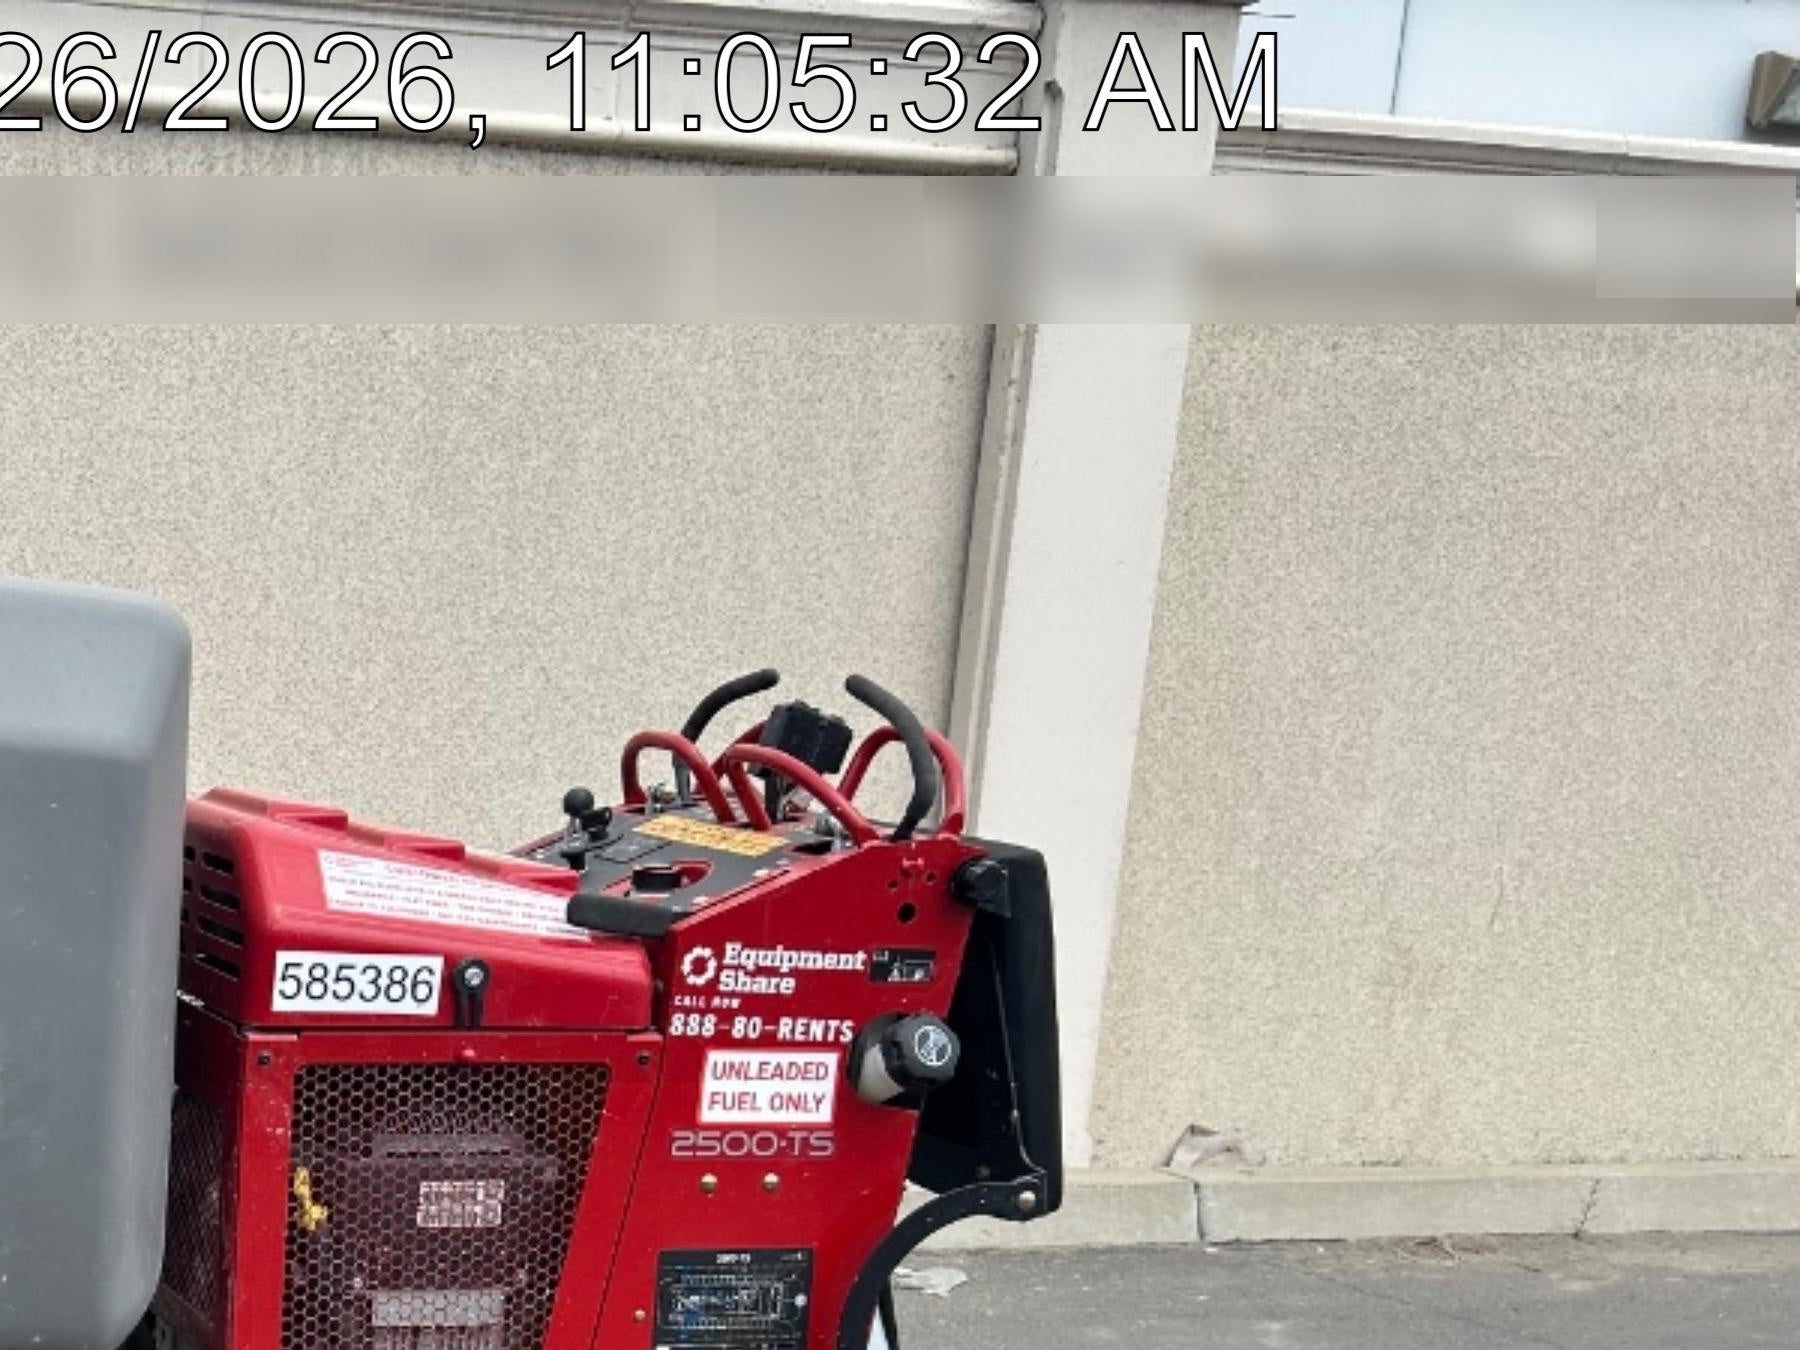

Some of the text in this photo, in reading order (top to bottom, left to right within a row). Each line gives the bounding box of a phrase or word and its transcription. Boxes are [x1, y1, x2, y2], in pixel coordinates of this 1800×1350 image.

[722, 941, 867, 973] Equipment
[278, 962, 436, 1005] 585386
[718, 969, 796, 995] Share
[711, 1061, 829, 1082] UNLEADED
[708, 1092, 826, 1114] FUEL ONLY
